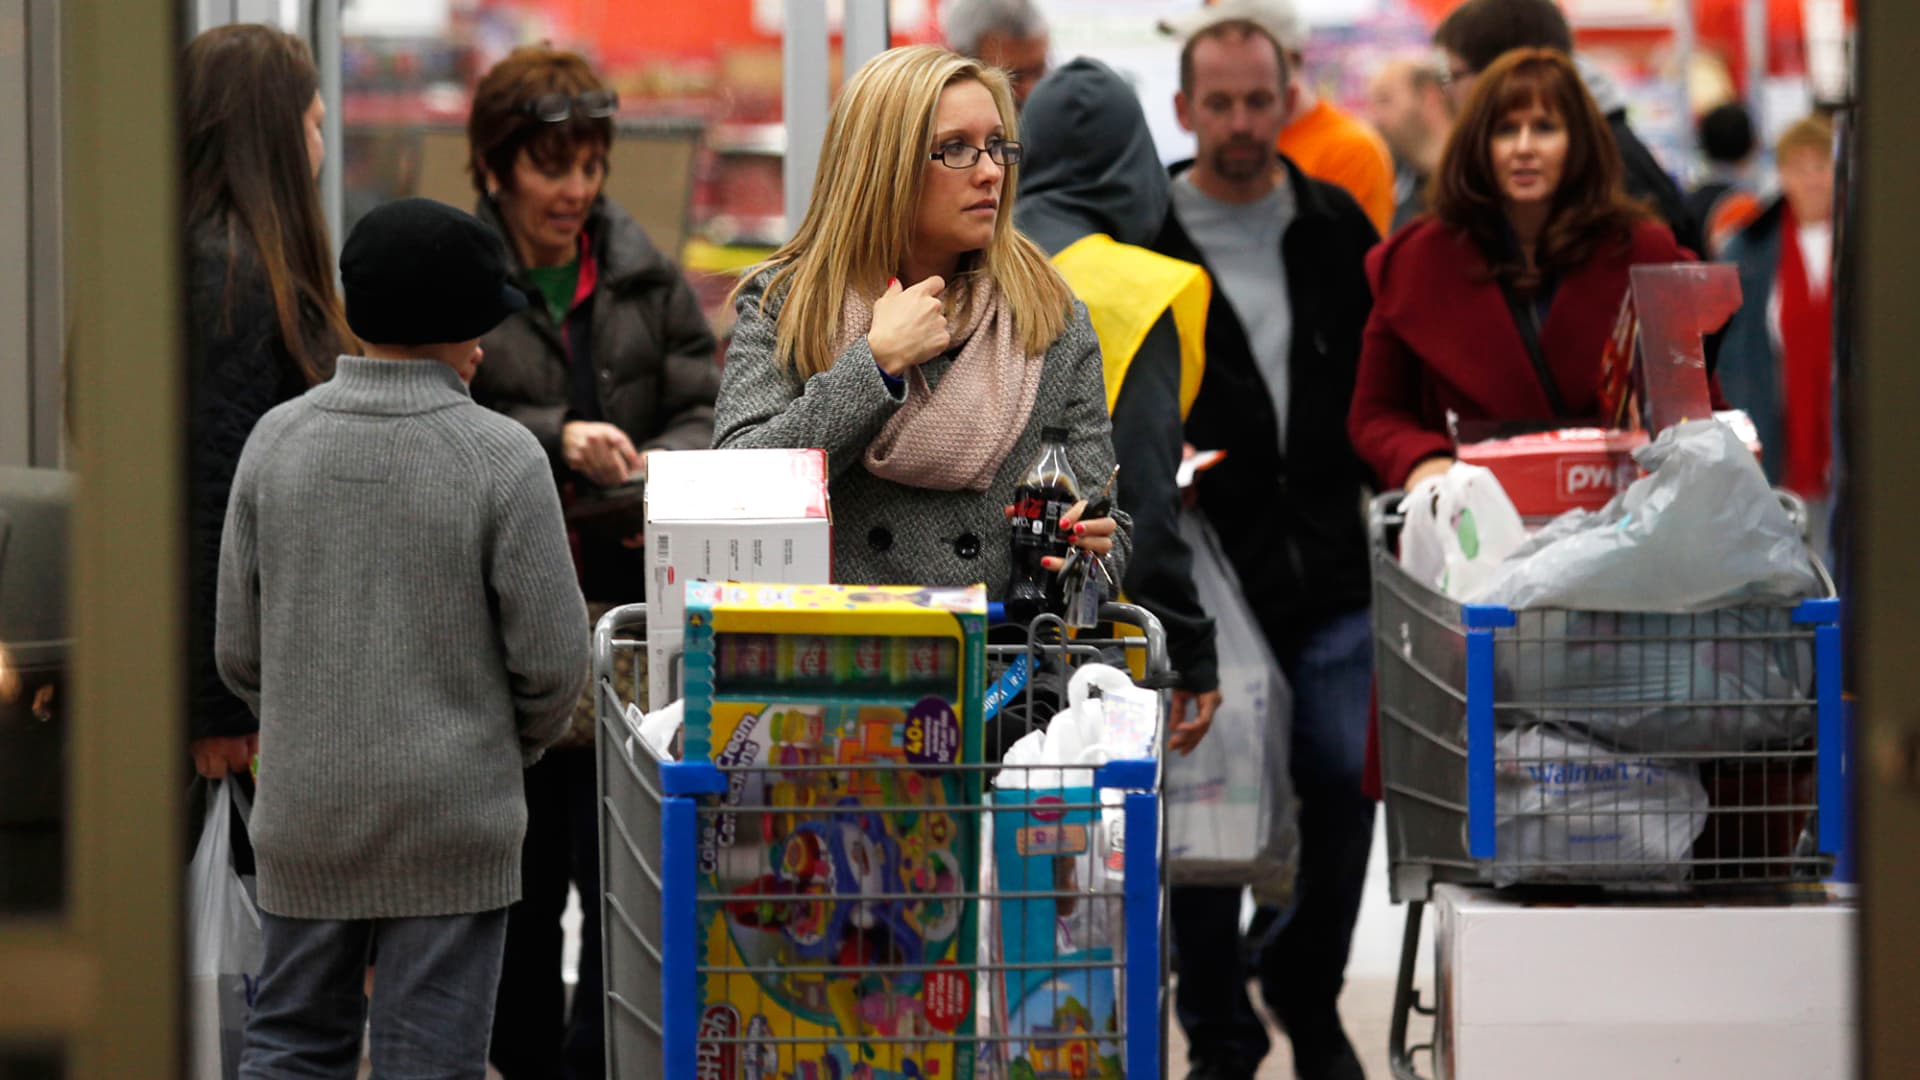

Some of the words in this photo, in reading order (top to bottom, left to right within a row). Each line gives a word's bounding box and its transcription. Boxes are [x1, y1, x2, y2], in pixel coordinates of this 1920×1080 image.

[701, 826, 717, 874] Cake
[716, 714, 757, 768] Cream
[1528, 761, 1629, 786] Walmart
